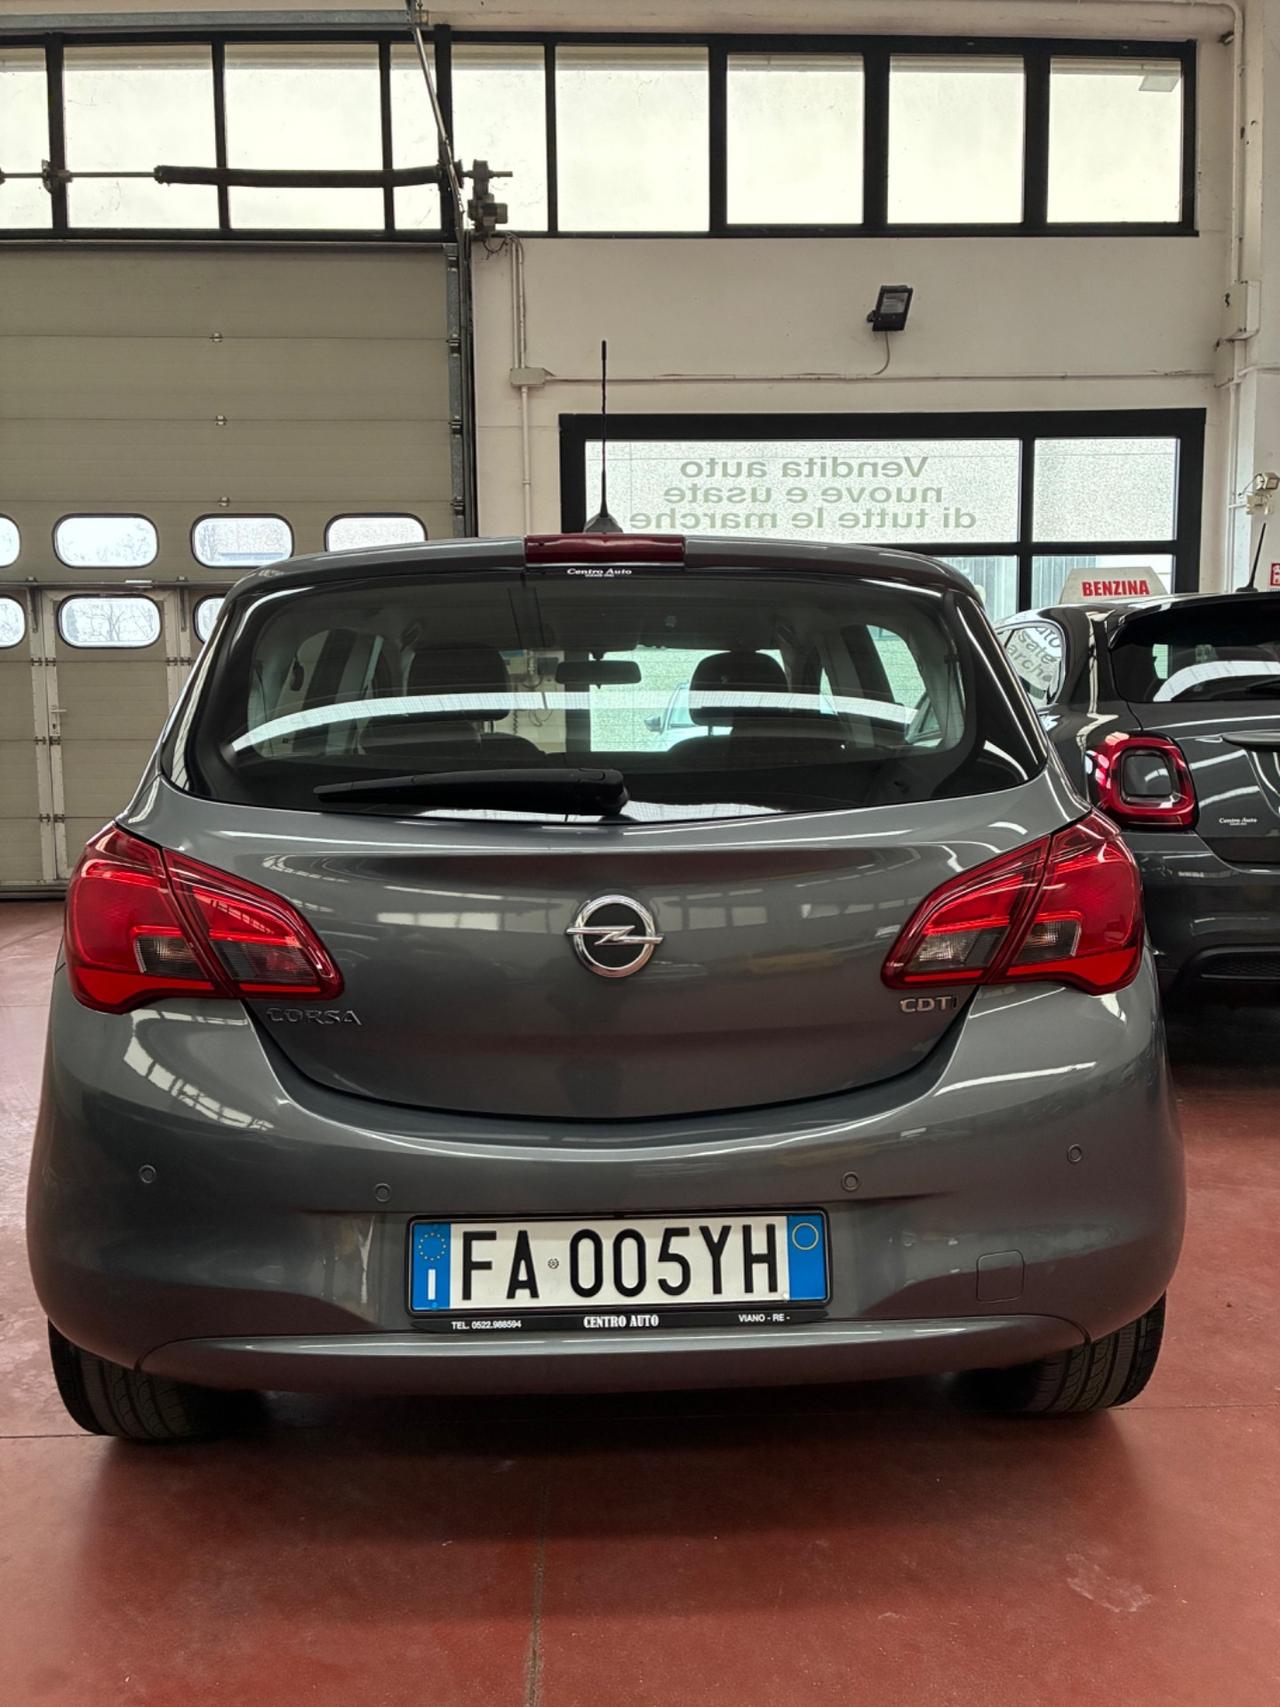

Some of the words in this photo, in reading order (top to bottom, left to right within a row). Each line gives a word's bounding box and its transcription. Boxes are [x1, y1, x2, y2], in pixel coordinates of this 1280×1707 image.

[566, 567, 604, 576] Centro
[605, 567, 633, 575] Auto
[1081, 579, 1150, 598] BENZINA
[265, 1006, 363, 1026] CORSA
[461, 1229, 540, 1301] FA
[451, 1320, 470, 1330] TEL.
[583, 1314, 627, 1329] CENTRO
[629, 1313, 660, 1328] AUTO
[738, 1313, 766, 1322] VIANO
[772, 1313, 785, 1322] RE
